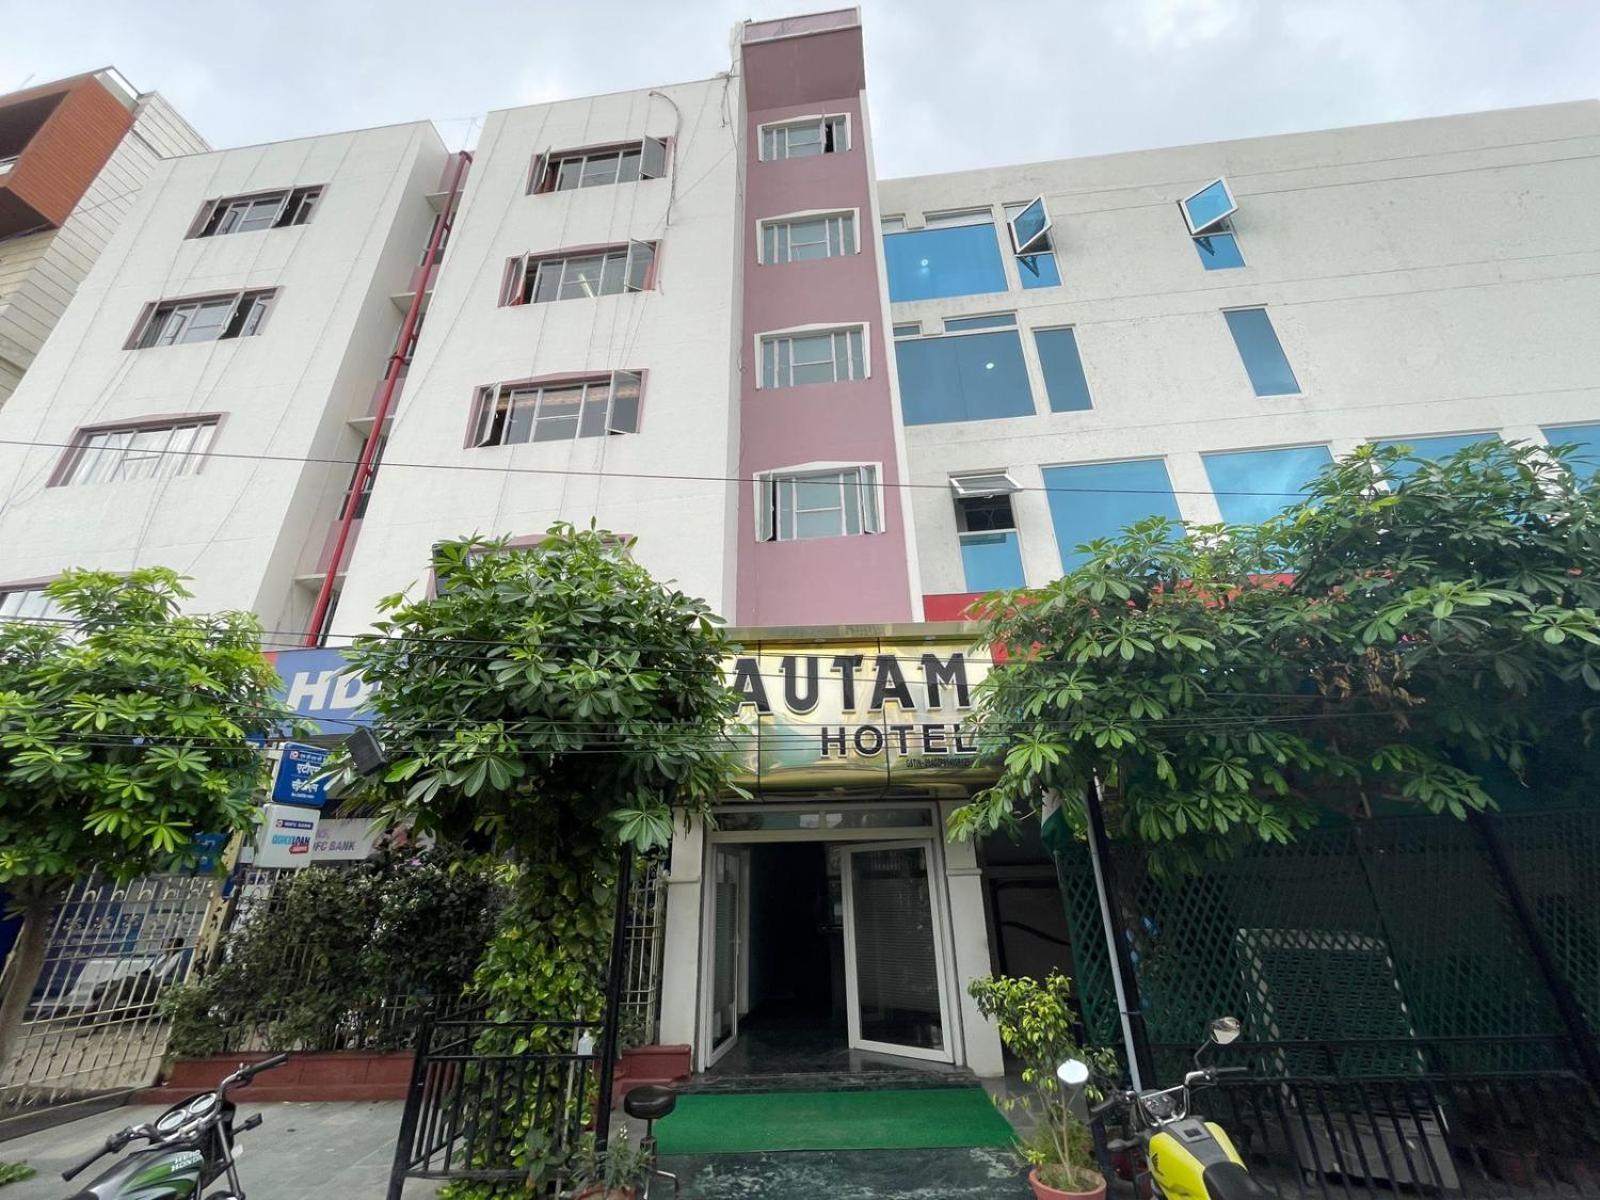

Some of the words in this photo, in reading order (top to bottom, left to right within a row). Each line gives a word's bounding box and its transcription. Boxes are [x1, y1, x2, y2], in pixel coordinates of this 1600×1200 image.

[286, 669, 382, 710] HD
[820, 723, 979, 758] HOTEL
[314, 841, 328, 851] FC
[329, 840, 355, 851] BANK
